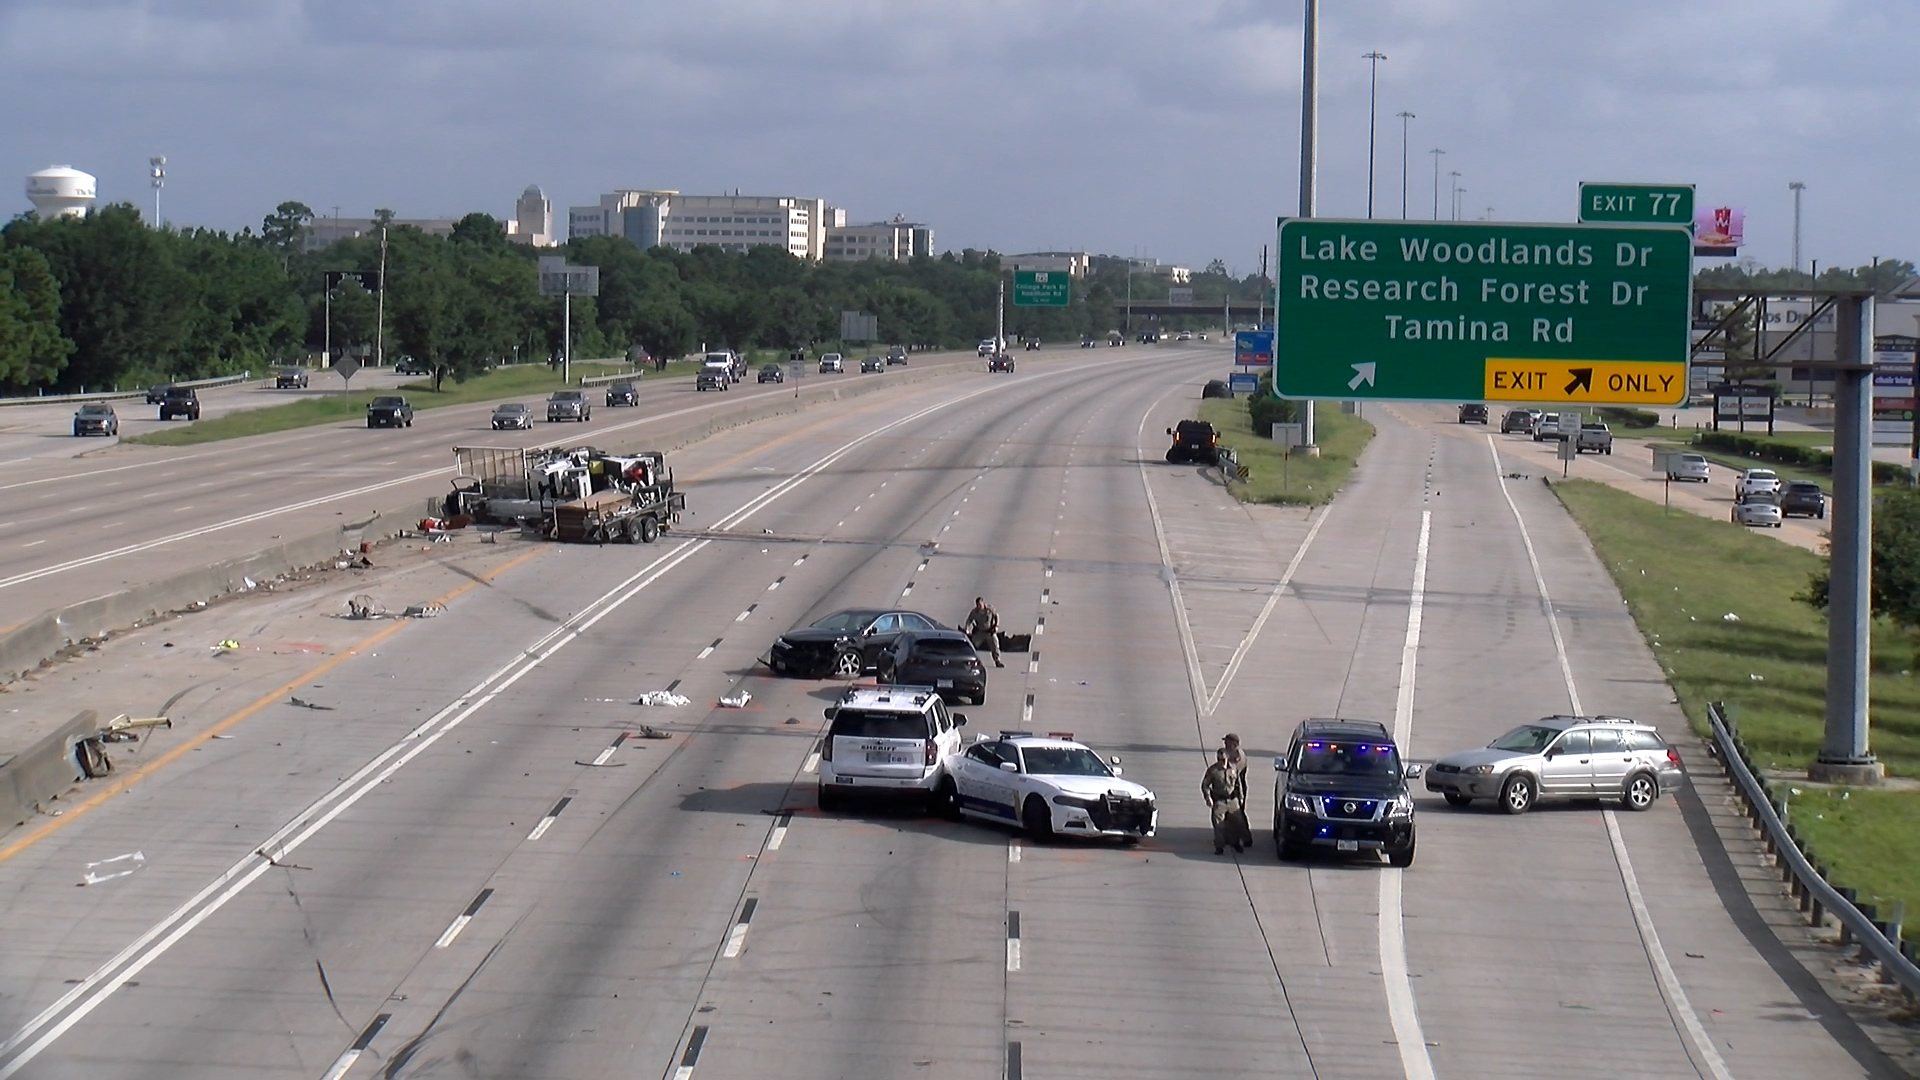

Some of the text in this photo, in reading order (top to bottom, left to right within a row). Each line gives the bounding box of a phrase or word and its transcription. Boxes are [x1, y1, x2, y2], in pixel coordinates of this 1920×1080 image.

[1593, 193, 1681, 216] EXIT 77
[1299, 235, 1653, 268] Lake Woodlands Dr
[1300, 274, 1649, 306] Research Forest Dr
[1385, 314, 1573, 343] Tamina Rd
[1494, 371, 1675, 393] EXIT ONLY
